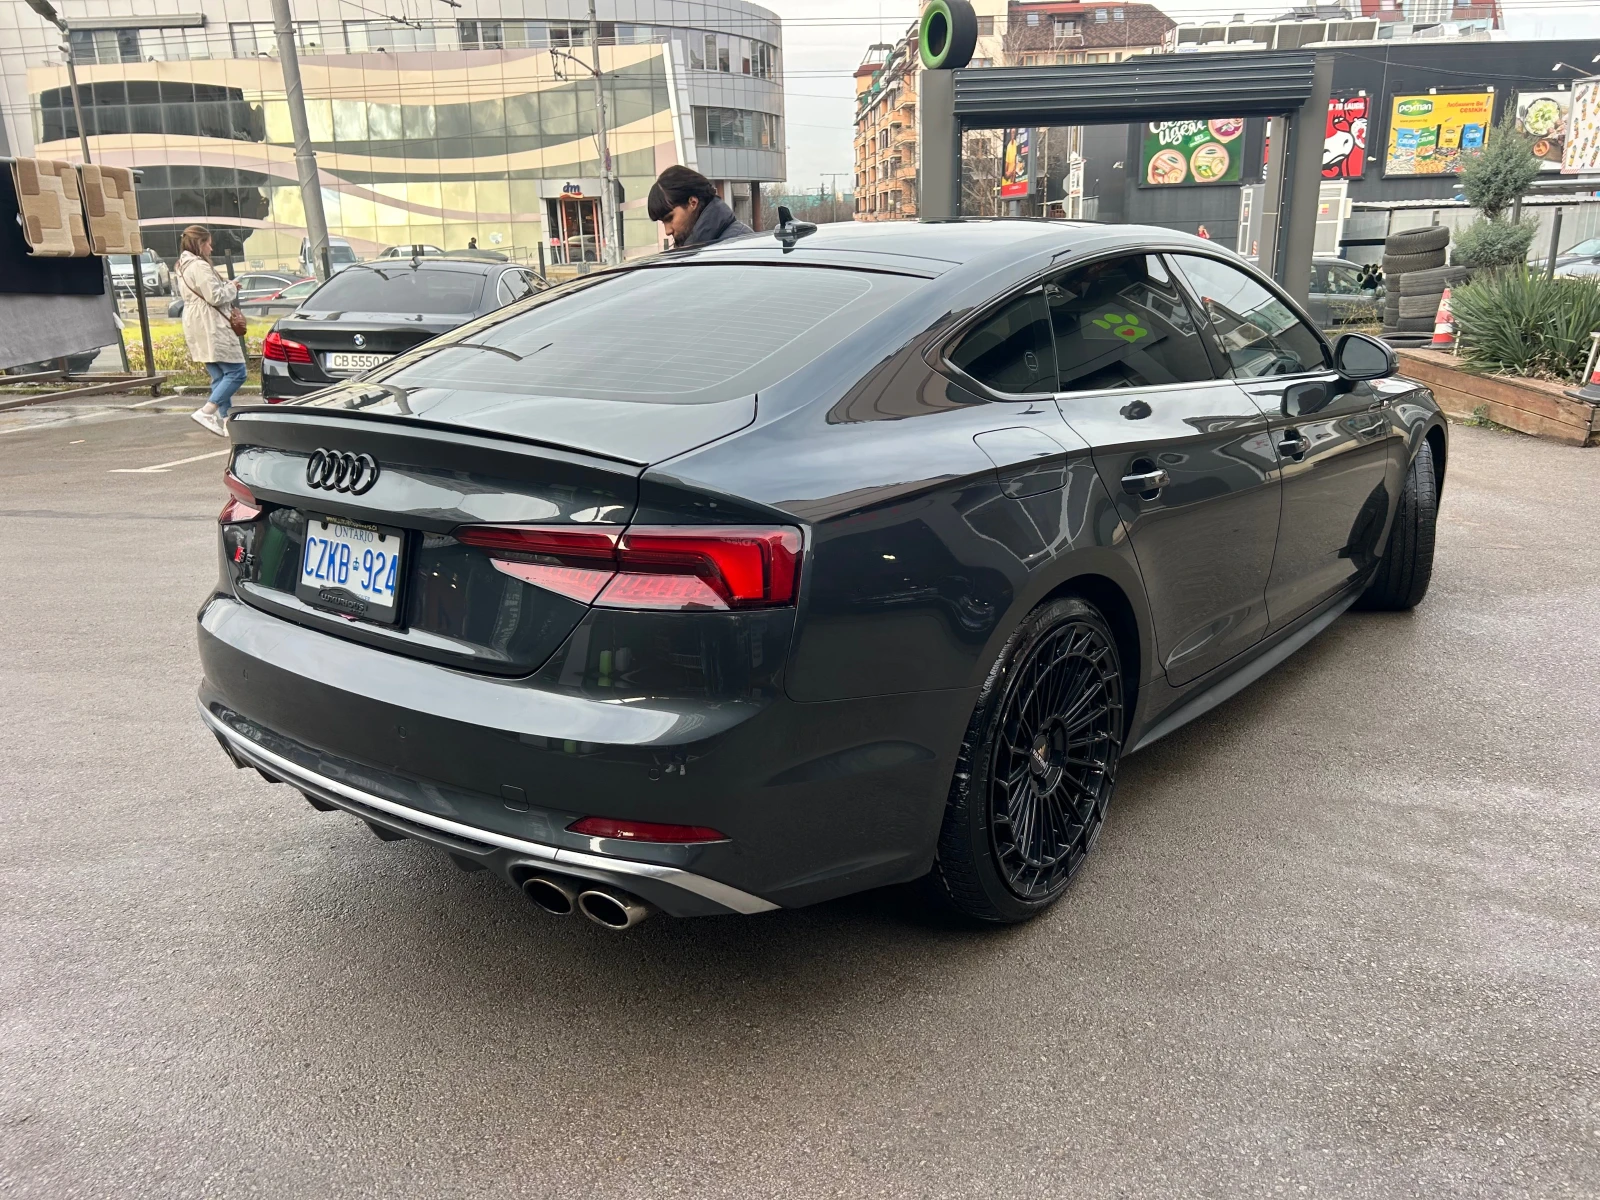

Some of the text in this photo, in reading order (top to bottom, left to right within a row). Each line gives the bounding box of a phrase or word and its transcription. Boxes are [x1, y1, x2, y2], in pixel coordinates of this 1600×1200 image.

[1398, 103, 1432, 113] peyman
[563, 182, 580, 193] dm
[334, 355, 349, 366] CB
[351, 355, 380, 368] 5550
[335, 525, 374, 544] ONTARIO
[305, 537, 398, 597] CZKB 924
